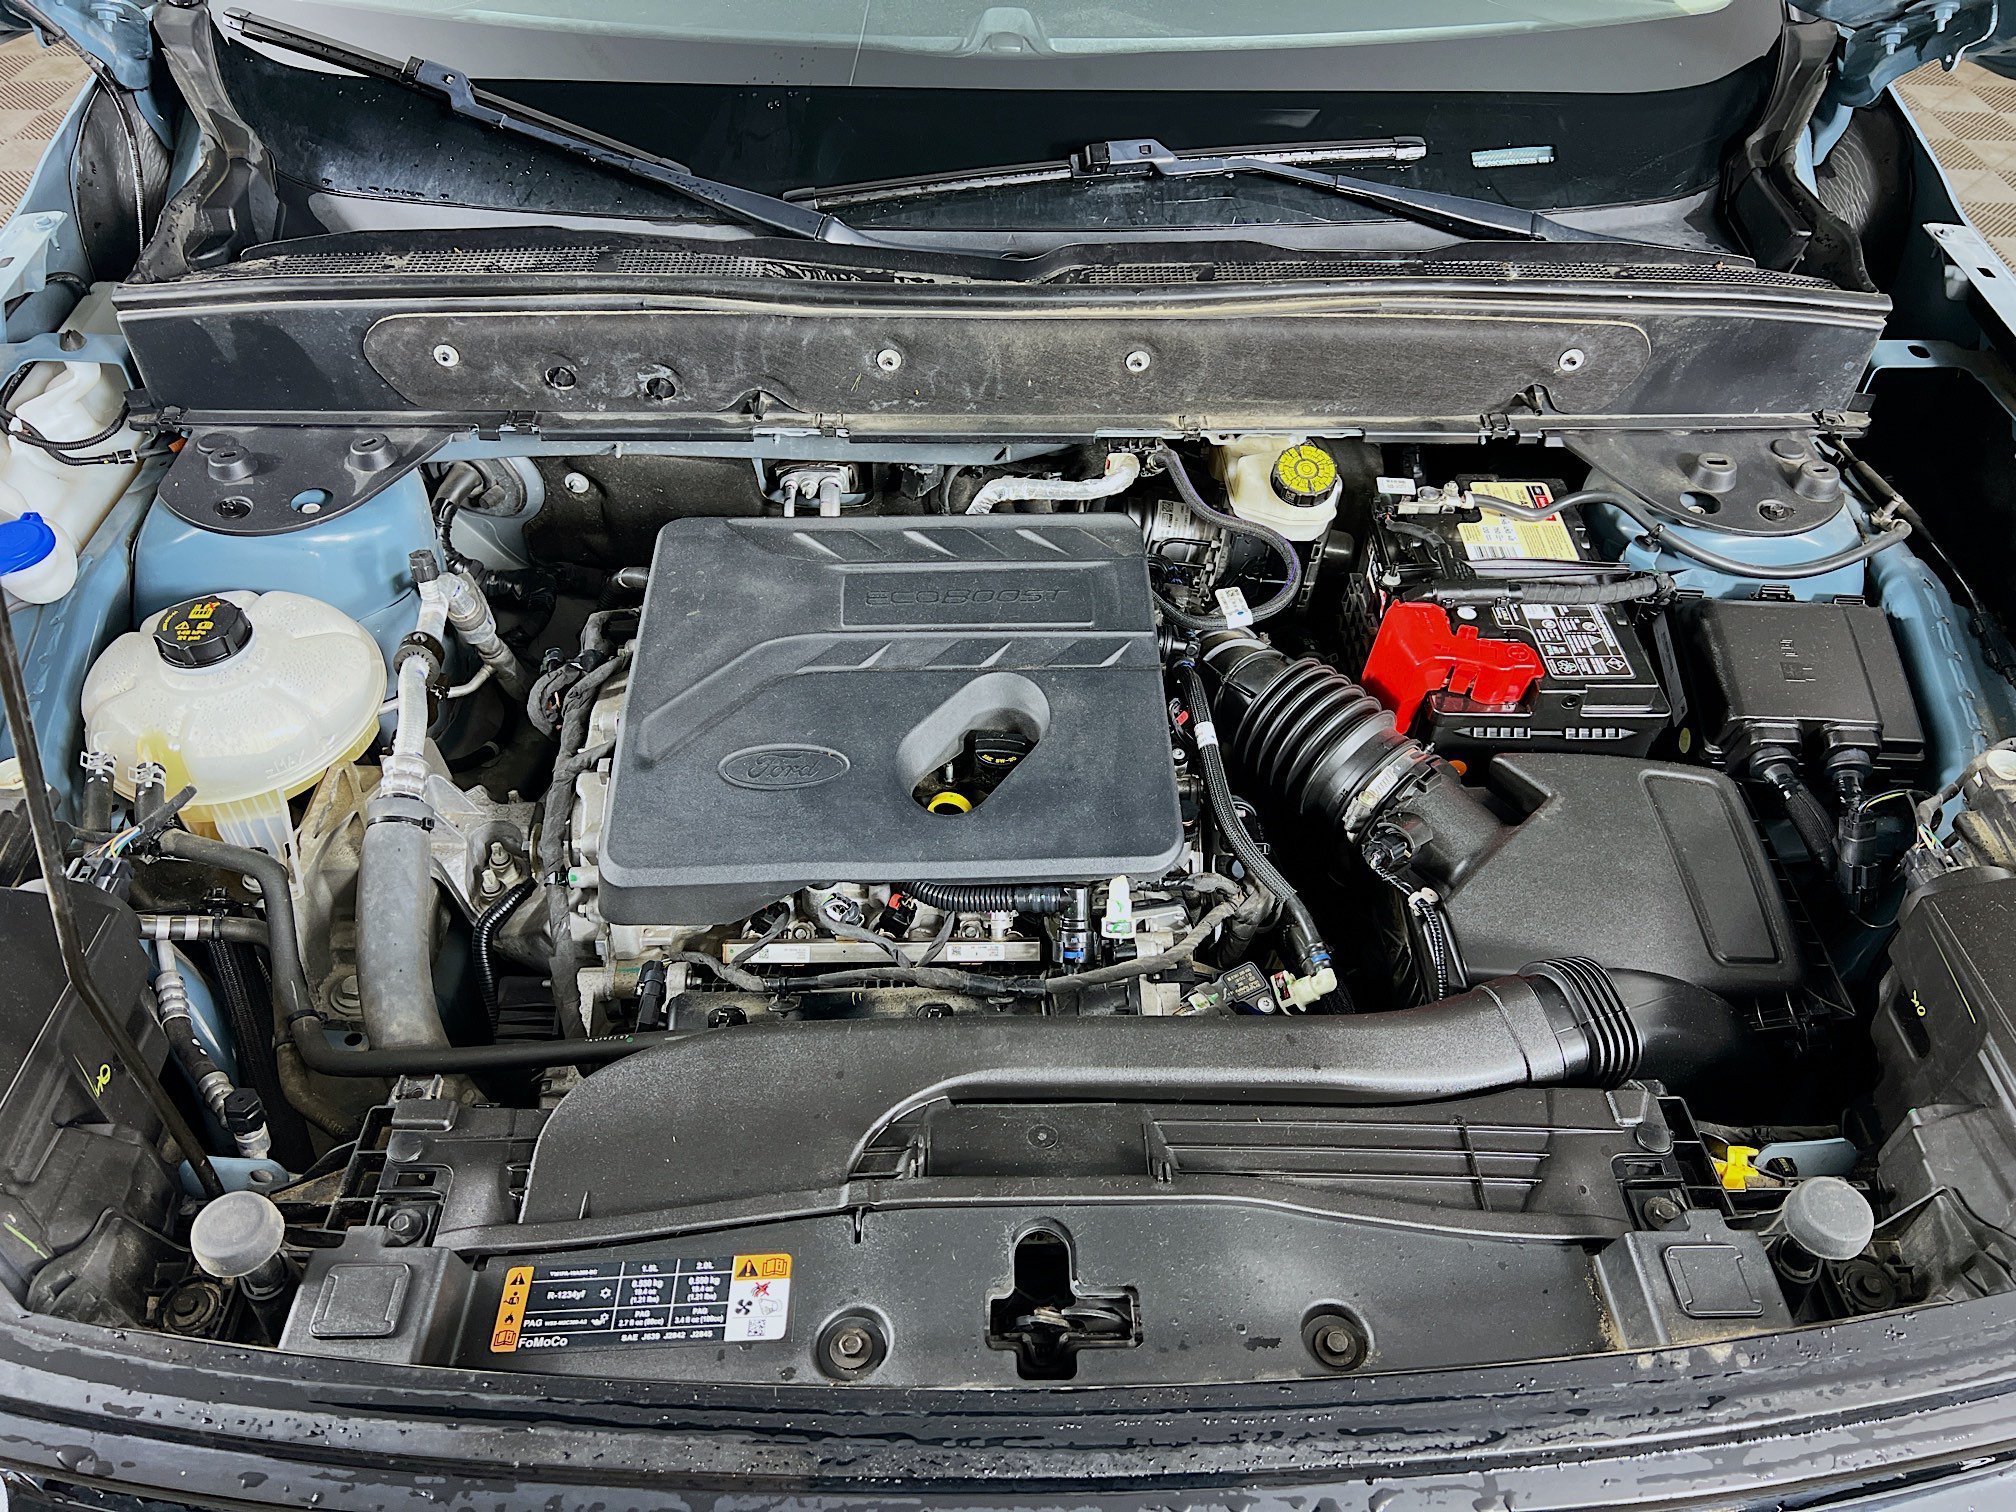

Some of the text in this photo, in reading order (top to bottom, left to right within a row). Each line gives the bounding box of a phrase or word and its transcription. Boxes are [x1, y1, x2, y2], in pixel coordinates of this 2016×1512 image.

[865, 589, 1069, 606] ECOBOOST
[748, 750, 821, 778] Ford
[652, 1278, 664, 1290] kg
[709, 1275, 721, 1287] kg
[546, 1289, 587, 1300] R-1234yf
[634, 1309, 651, 1318] PAG
[692, 1307, 709, 1315] PAG
[523, 1319, 543, 1328] PAG
[517, 1335, 569, 1349] FoMoCo
[620, 1333, 639, 1342] SAE
[641, 1332, 661, 1341] J639
